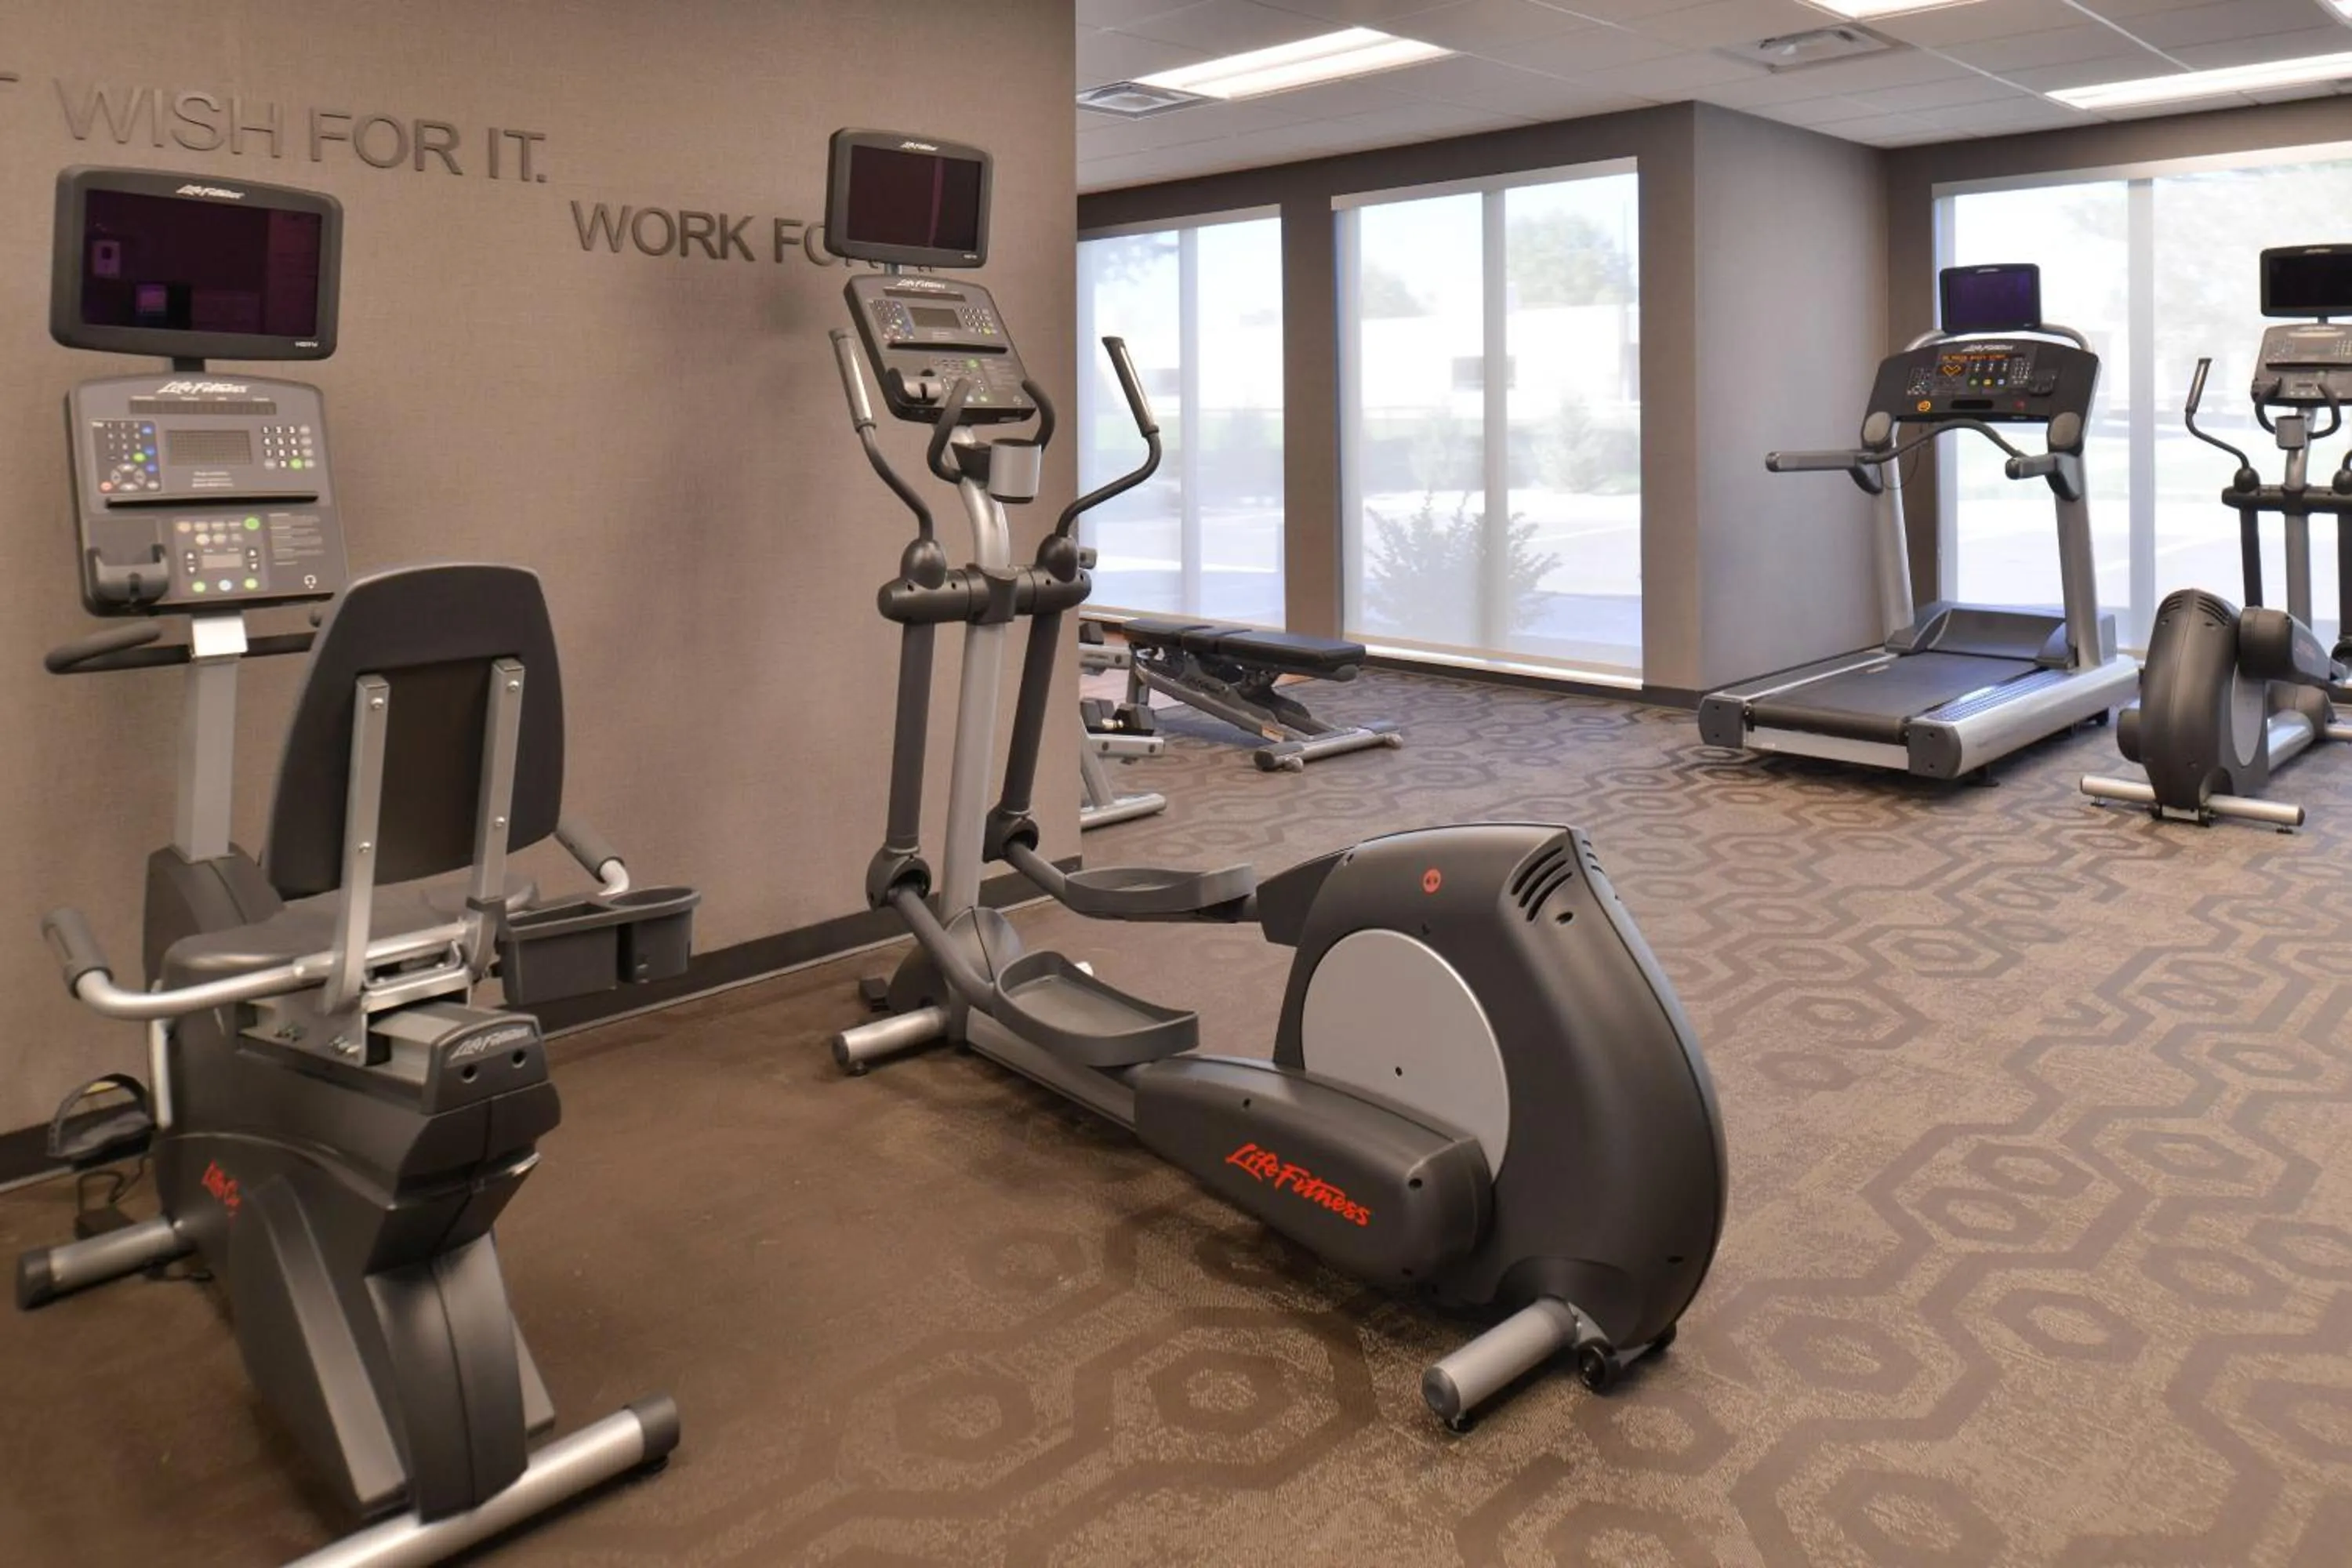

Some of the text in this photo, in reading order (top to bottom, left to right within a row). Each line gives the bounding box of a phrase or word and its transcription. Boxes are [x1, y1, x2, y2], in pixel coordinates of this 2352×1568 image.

[52, 78, 546, 183] WISH FOR IT.
[571, 200, 879, 270] WORK FO
